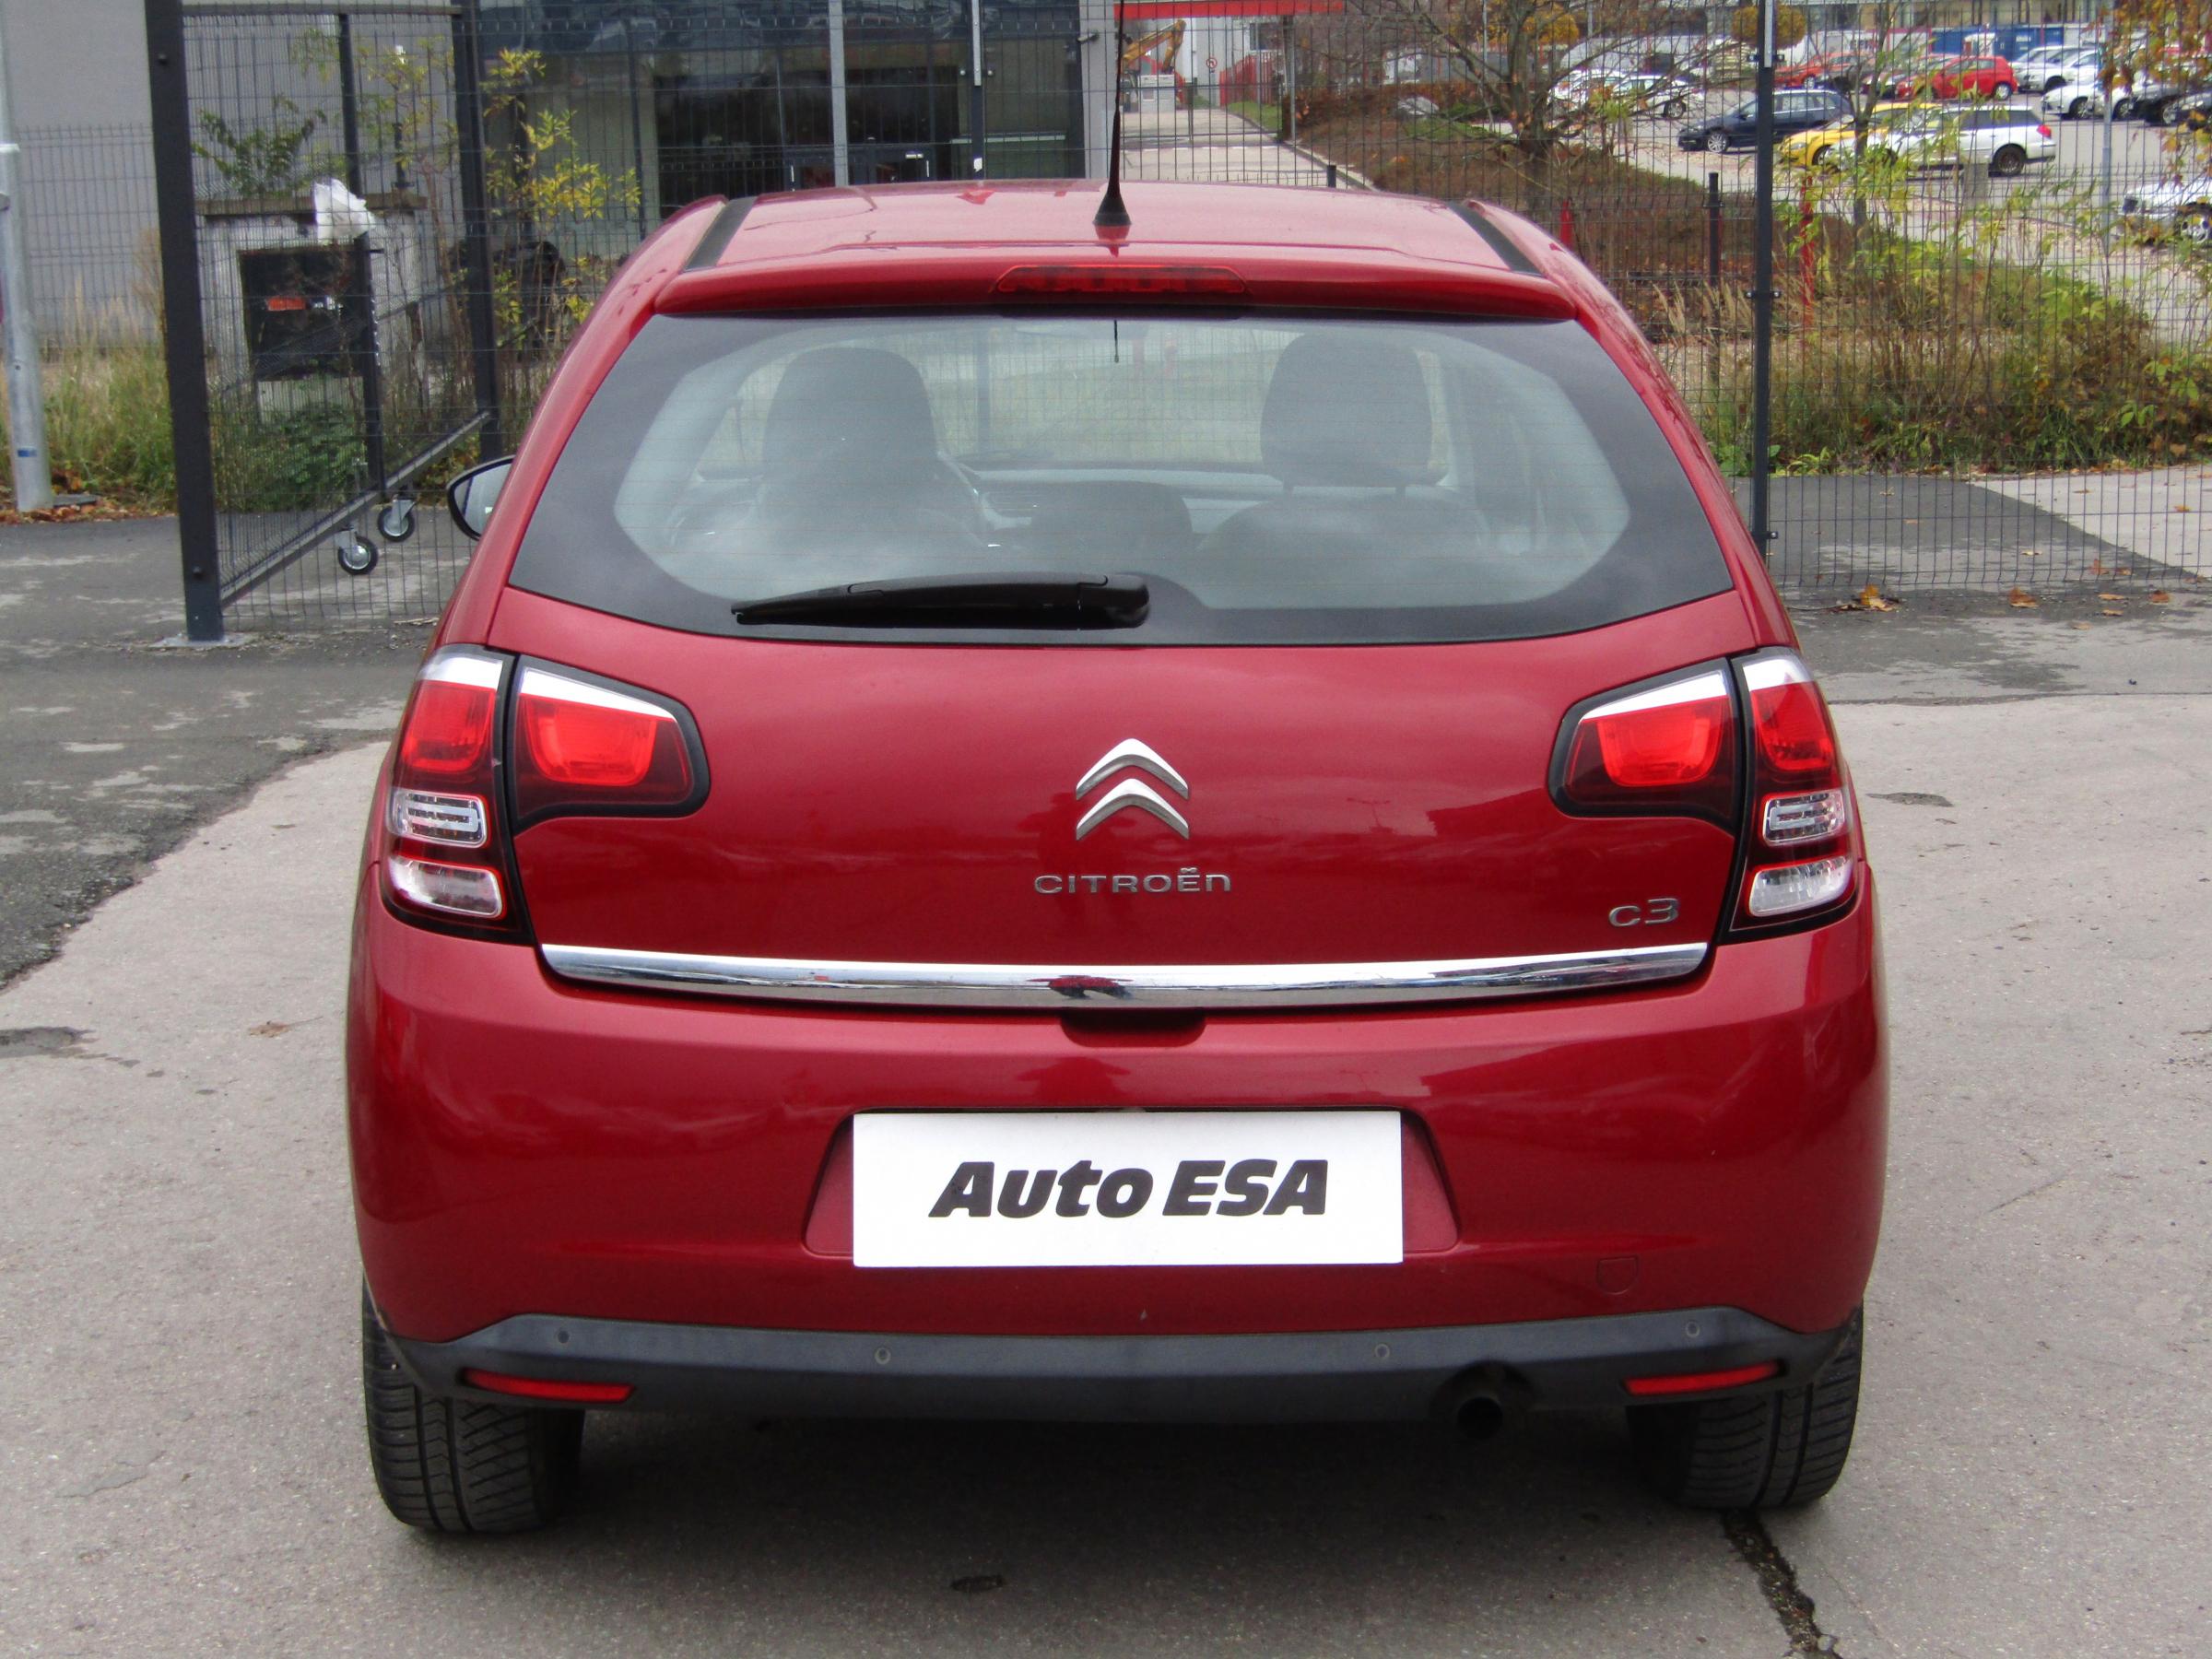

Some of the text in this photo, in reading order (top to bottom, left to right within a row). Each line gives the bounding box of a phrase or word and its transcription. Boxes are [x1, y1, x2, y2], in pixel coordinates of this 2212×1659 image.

[1608, 897, 1679, 926] C3
[928, 1159, 1327, 1218] Auto ESA
